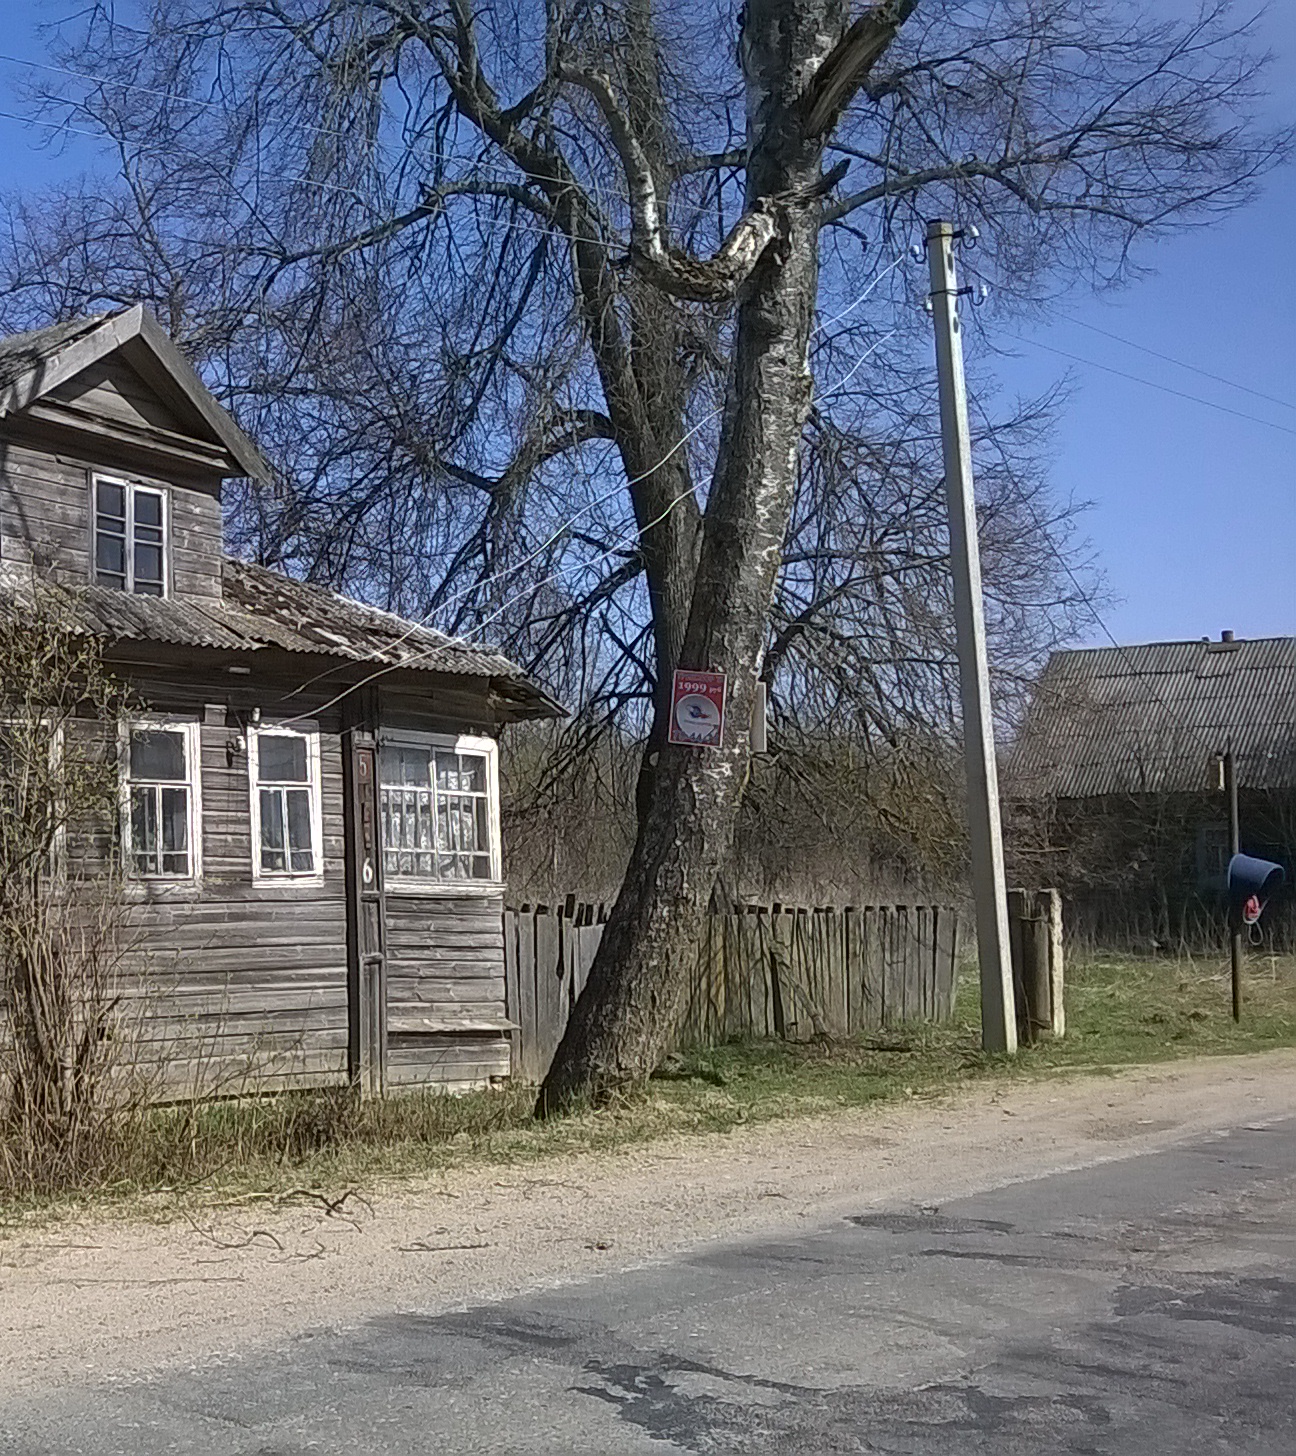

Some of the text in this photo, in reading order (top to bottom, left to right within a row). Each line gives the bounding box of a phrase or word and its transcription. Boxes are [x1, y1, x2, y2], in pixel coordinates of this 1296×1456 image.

[679, 682, 707, 693] 1999
[359, 754, 367, 777] 5
[363, 857, 373, 883] 6
